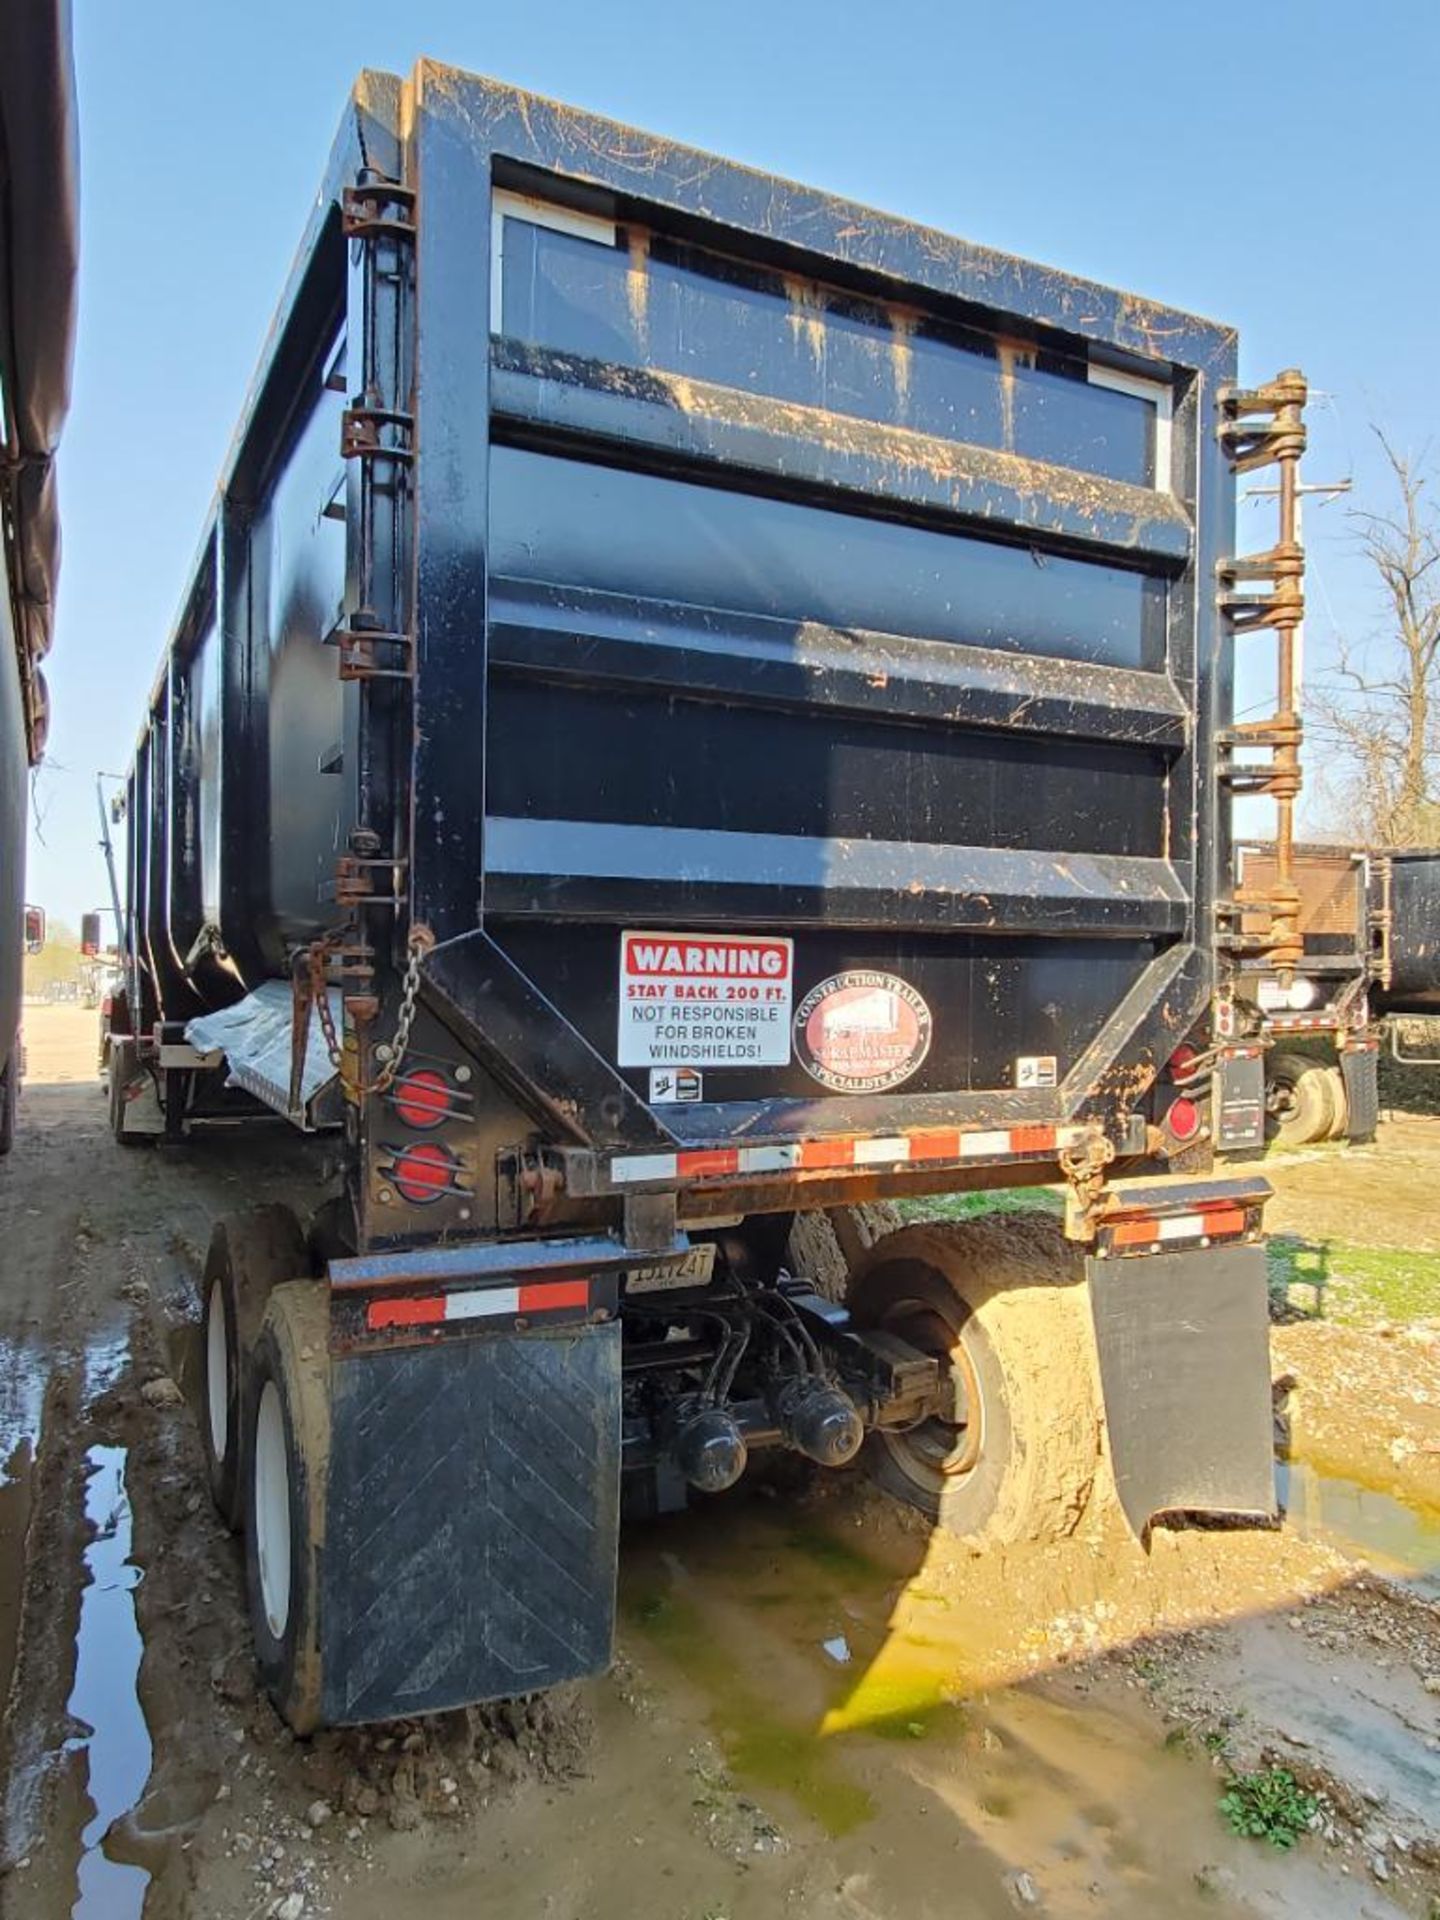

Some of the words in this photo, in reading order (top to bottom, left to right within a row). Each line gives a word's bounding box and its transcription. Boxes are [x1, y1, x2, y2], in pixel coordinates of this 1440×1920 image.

[632, 944, 783, 975] WARNING
[627, 984, 667, 998] STAY
[675, 985, 719, 999] BACK
[726, 986, 759, 1000] 200
[766, 987, 787, 1001] FT.
[797, 974, 884, 1028] CONSTRUCTION
[886, 976, 928, 1025] TRAILER
[632, 1006, 665, 1021] NOT
[671, 1006, 778, 1022] RESPONSIBLE
[655, 1026, 687, 1040] FOR
[692, 1026, 757, 1041] BROKEN
[649, 1045, 762, 1059] WINDSHIELDS!
